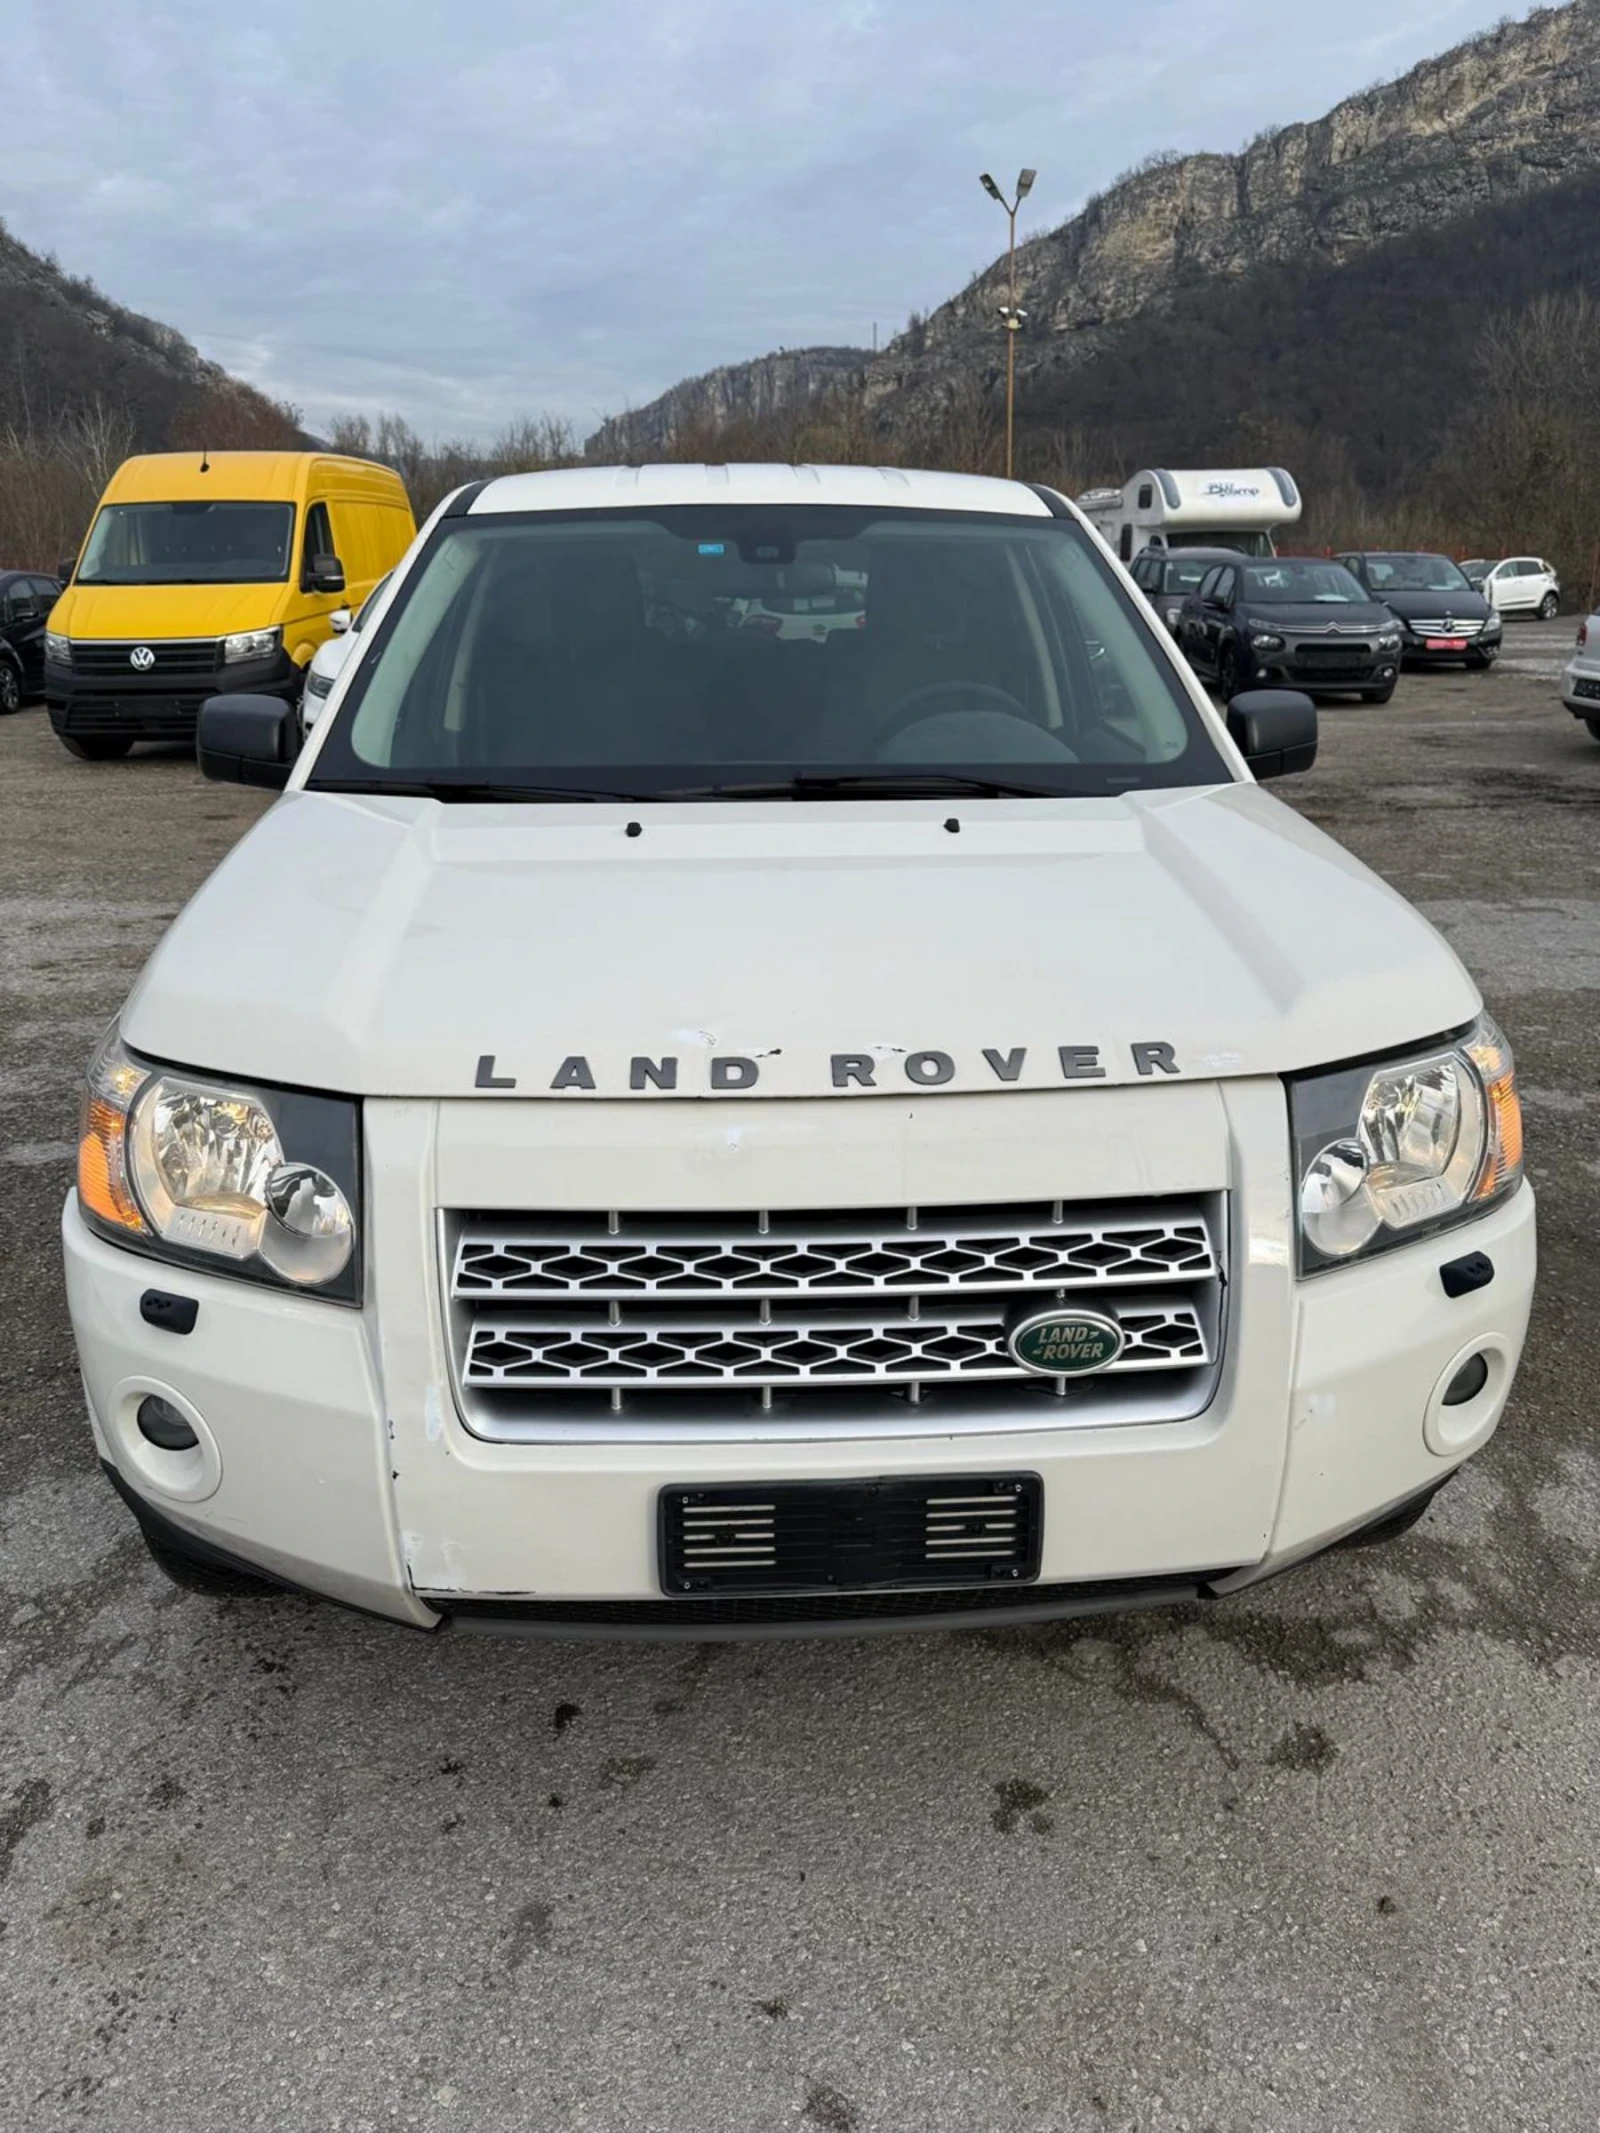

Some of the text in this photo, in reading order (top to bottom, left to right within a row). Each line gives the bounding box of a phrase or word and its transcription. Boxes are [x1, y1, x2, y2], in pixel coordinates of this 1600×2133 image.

[474, 1041, 1180, 1090] LAND ROVER
[1038, 1326, 1088, 1344] LAND
[1042, 1342, 1104, 1360] ROVER
